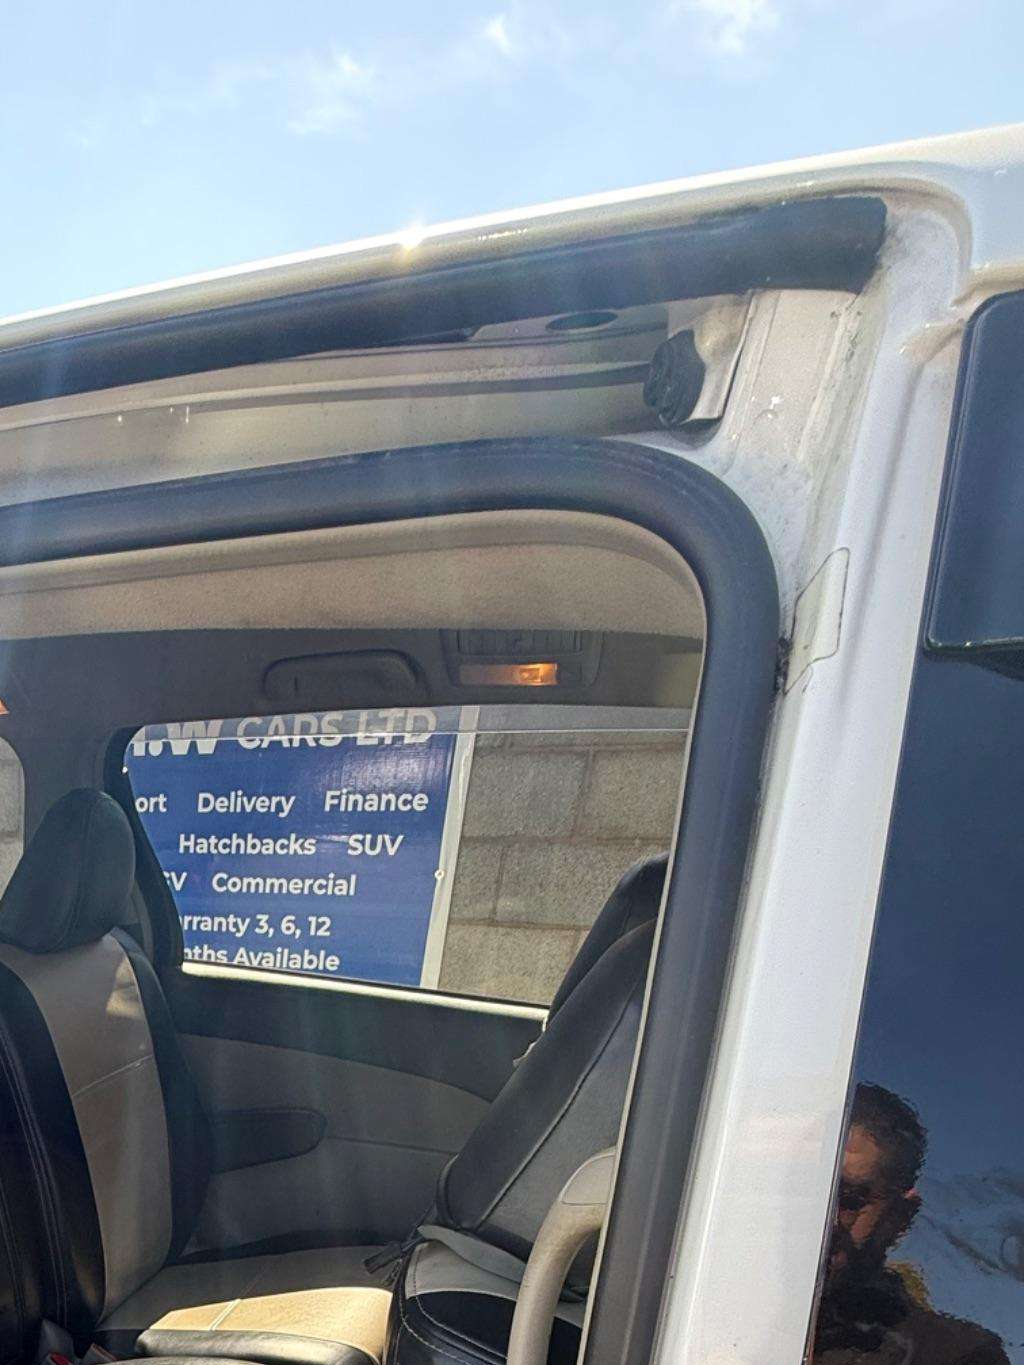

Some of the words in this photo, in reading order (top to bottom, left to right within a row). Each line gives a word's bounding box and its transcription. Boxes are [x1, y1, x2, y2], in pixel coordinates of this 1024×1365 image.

[237, 714, 346, 750] CARS
[356, 708, 437, 747] LTD
[135, 793, 168, 813] ort
[197, 790, 296, 818] Delivery
[324, 788, 429, 812] Finance
[178, 833, 317, 856] Hatchbacks
[347, 833, 404, 856] SUV
[212, 871, 357, 897] Commercial
[179, 913, 251, 938] rranty
[254, 914, 275, 937] 3,
[280, 915, 302, 938] 6,
[308, 915, 332, 937] 12
[232, 946, 341, 972] Available
